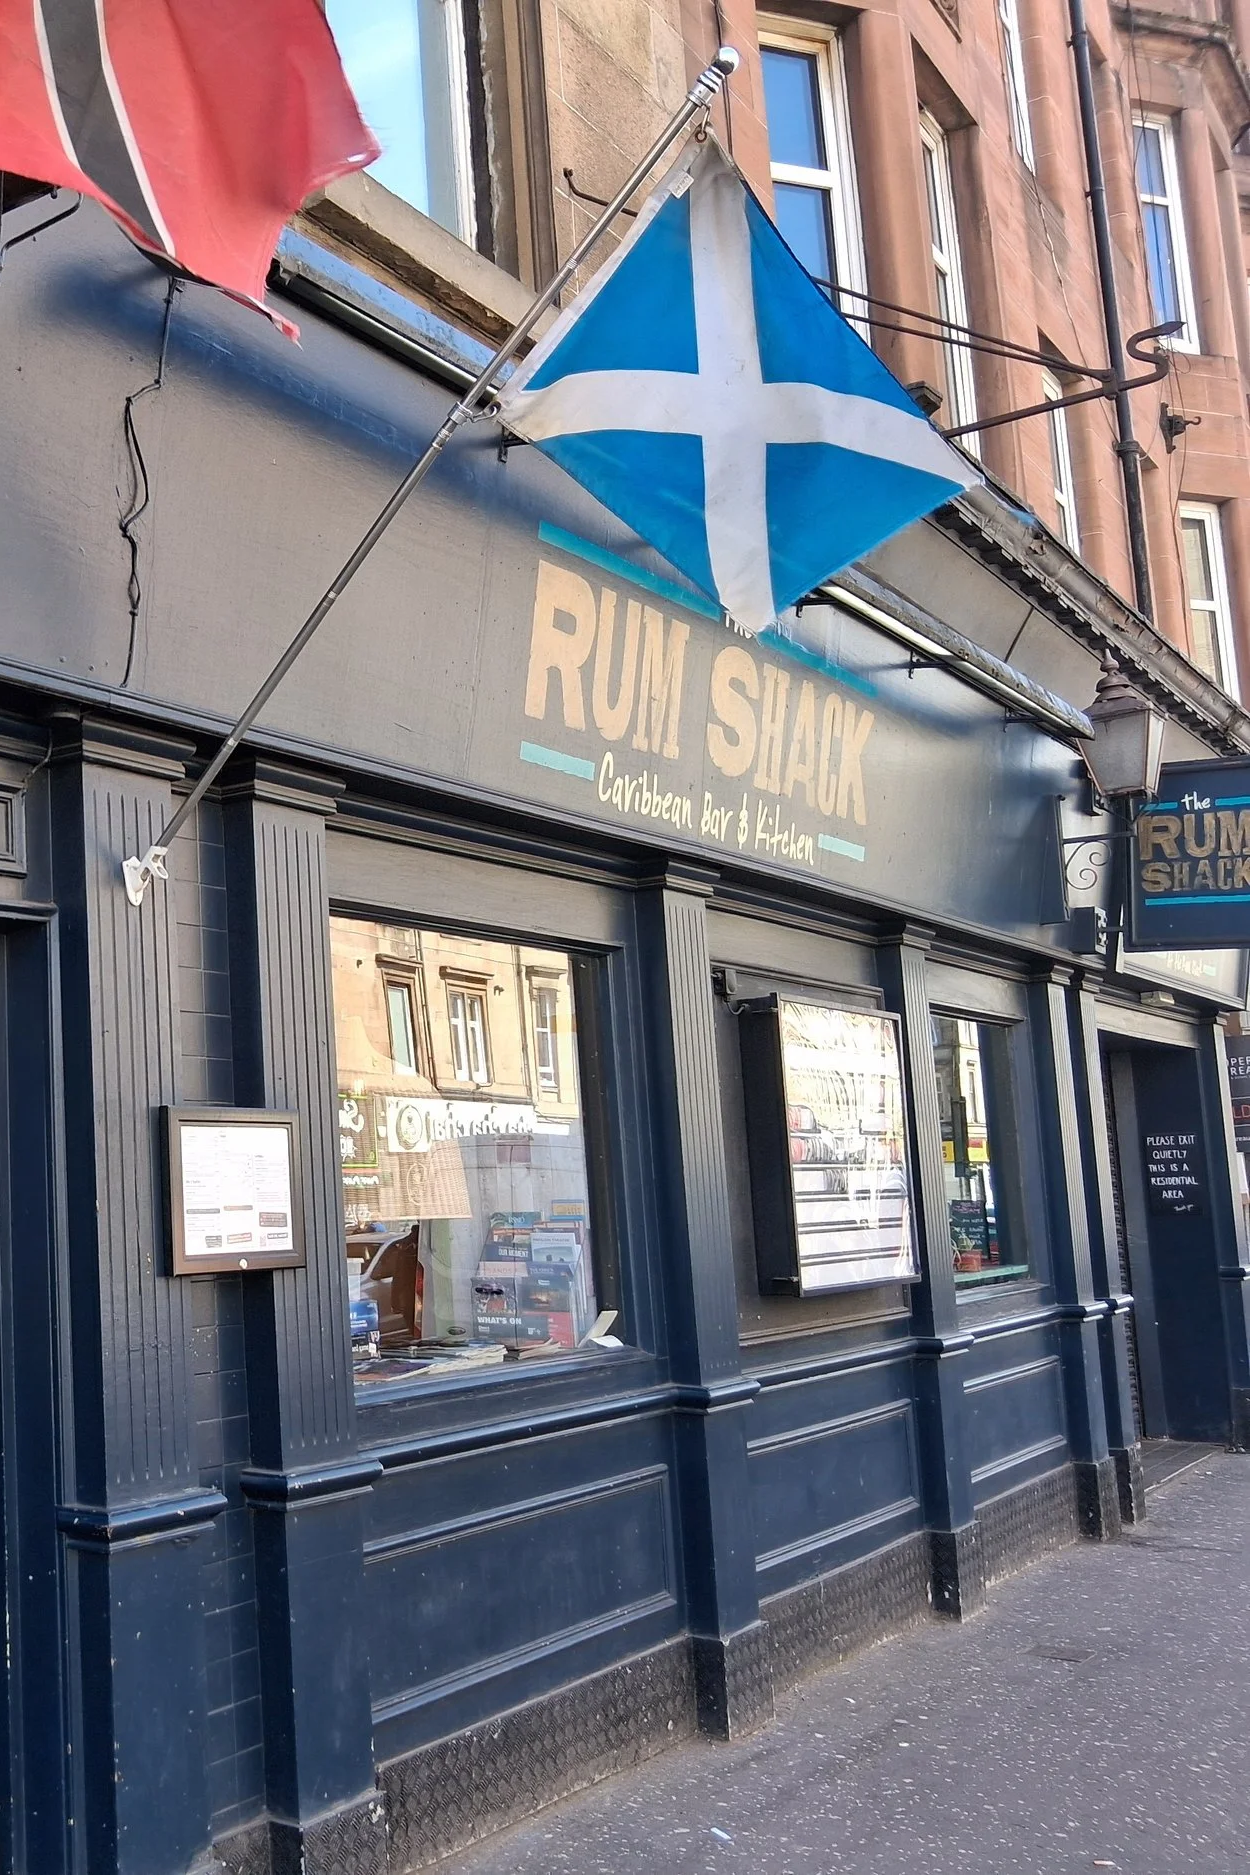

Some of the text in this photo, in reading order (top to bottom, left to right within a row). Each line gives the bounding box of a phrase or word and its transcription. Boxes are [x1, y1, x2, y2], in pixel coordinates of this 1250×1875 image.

[525, 560, 875, 826] RUM SHACK
[1181, 791, 1211, 811] the
[597, 751, 814, 866] Caribbean Bar & Kitchen
[1137, 810, 1250, 861] RUM
[1141, 857, 1250, 893] SHACK
[1146, 1134, 1196, 1146] PLEASE EXIT
[1152, 1150, 1187, 1160] QUIETLY
[1148, 1163, 1190, 1173] THIS IS A
[1151, 1176, 1199, 1186] RESIDENTIAL
[1162, 1189, 1184, 1199] AREA
[477, 1316, 522, 1325] WHAT'S ON
